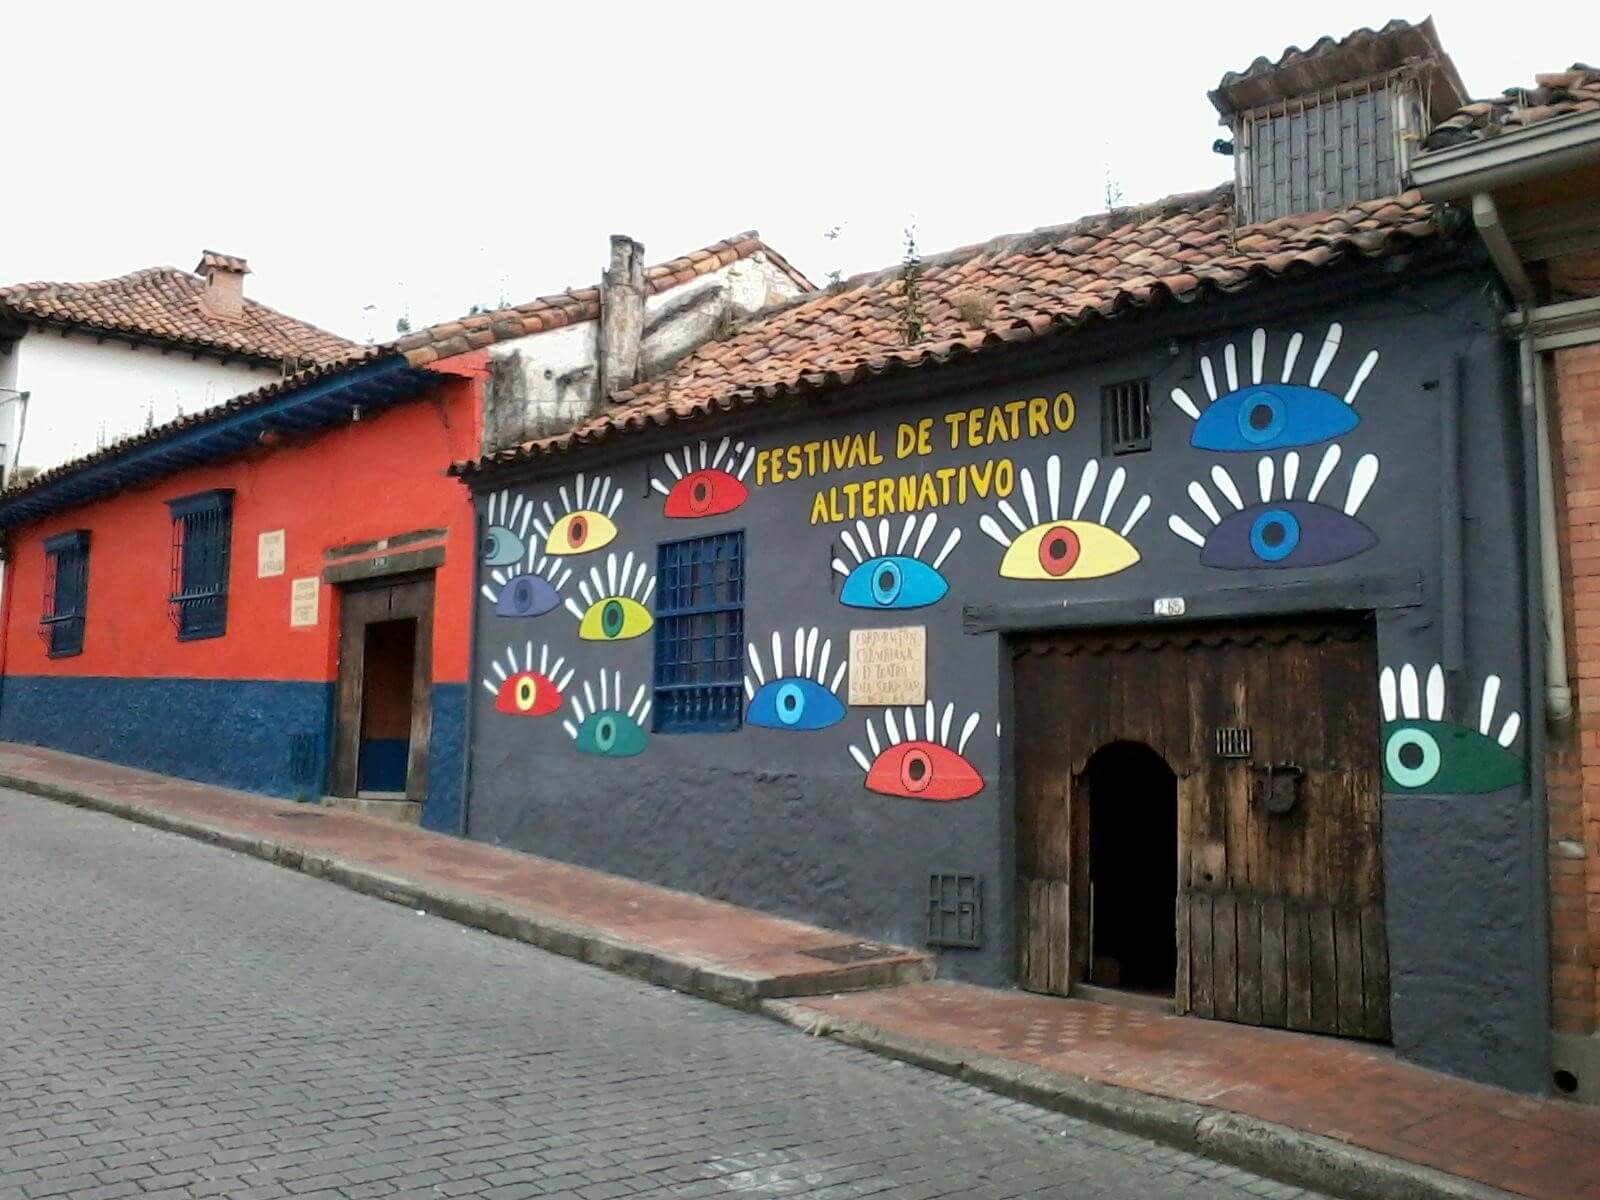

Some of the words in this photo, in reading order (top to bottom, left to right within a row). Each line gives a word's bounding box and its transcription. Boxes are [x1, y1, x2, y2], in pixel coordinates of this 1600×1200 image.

[756, 430, 883, 486] FESTIVAL
[896, 418, 934, 459] DE
[944, 391, 1076, 449] TEATRO
[809, 457, 1015, 526] ALTERNATIVO
